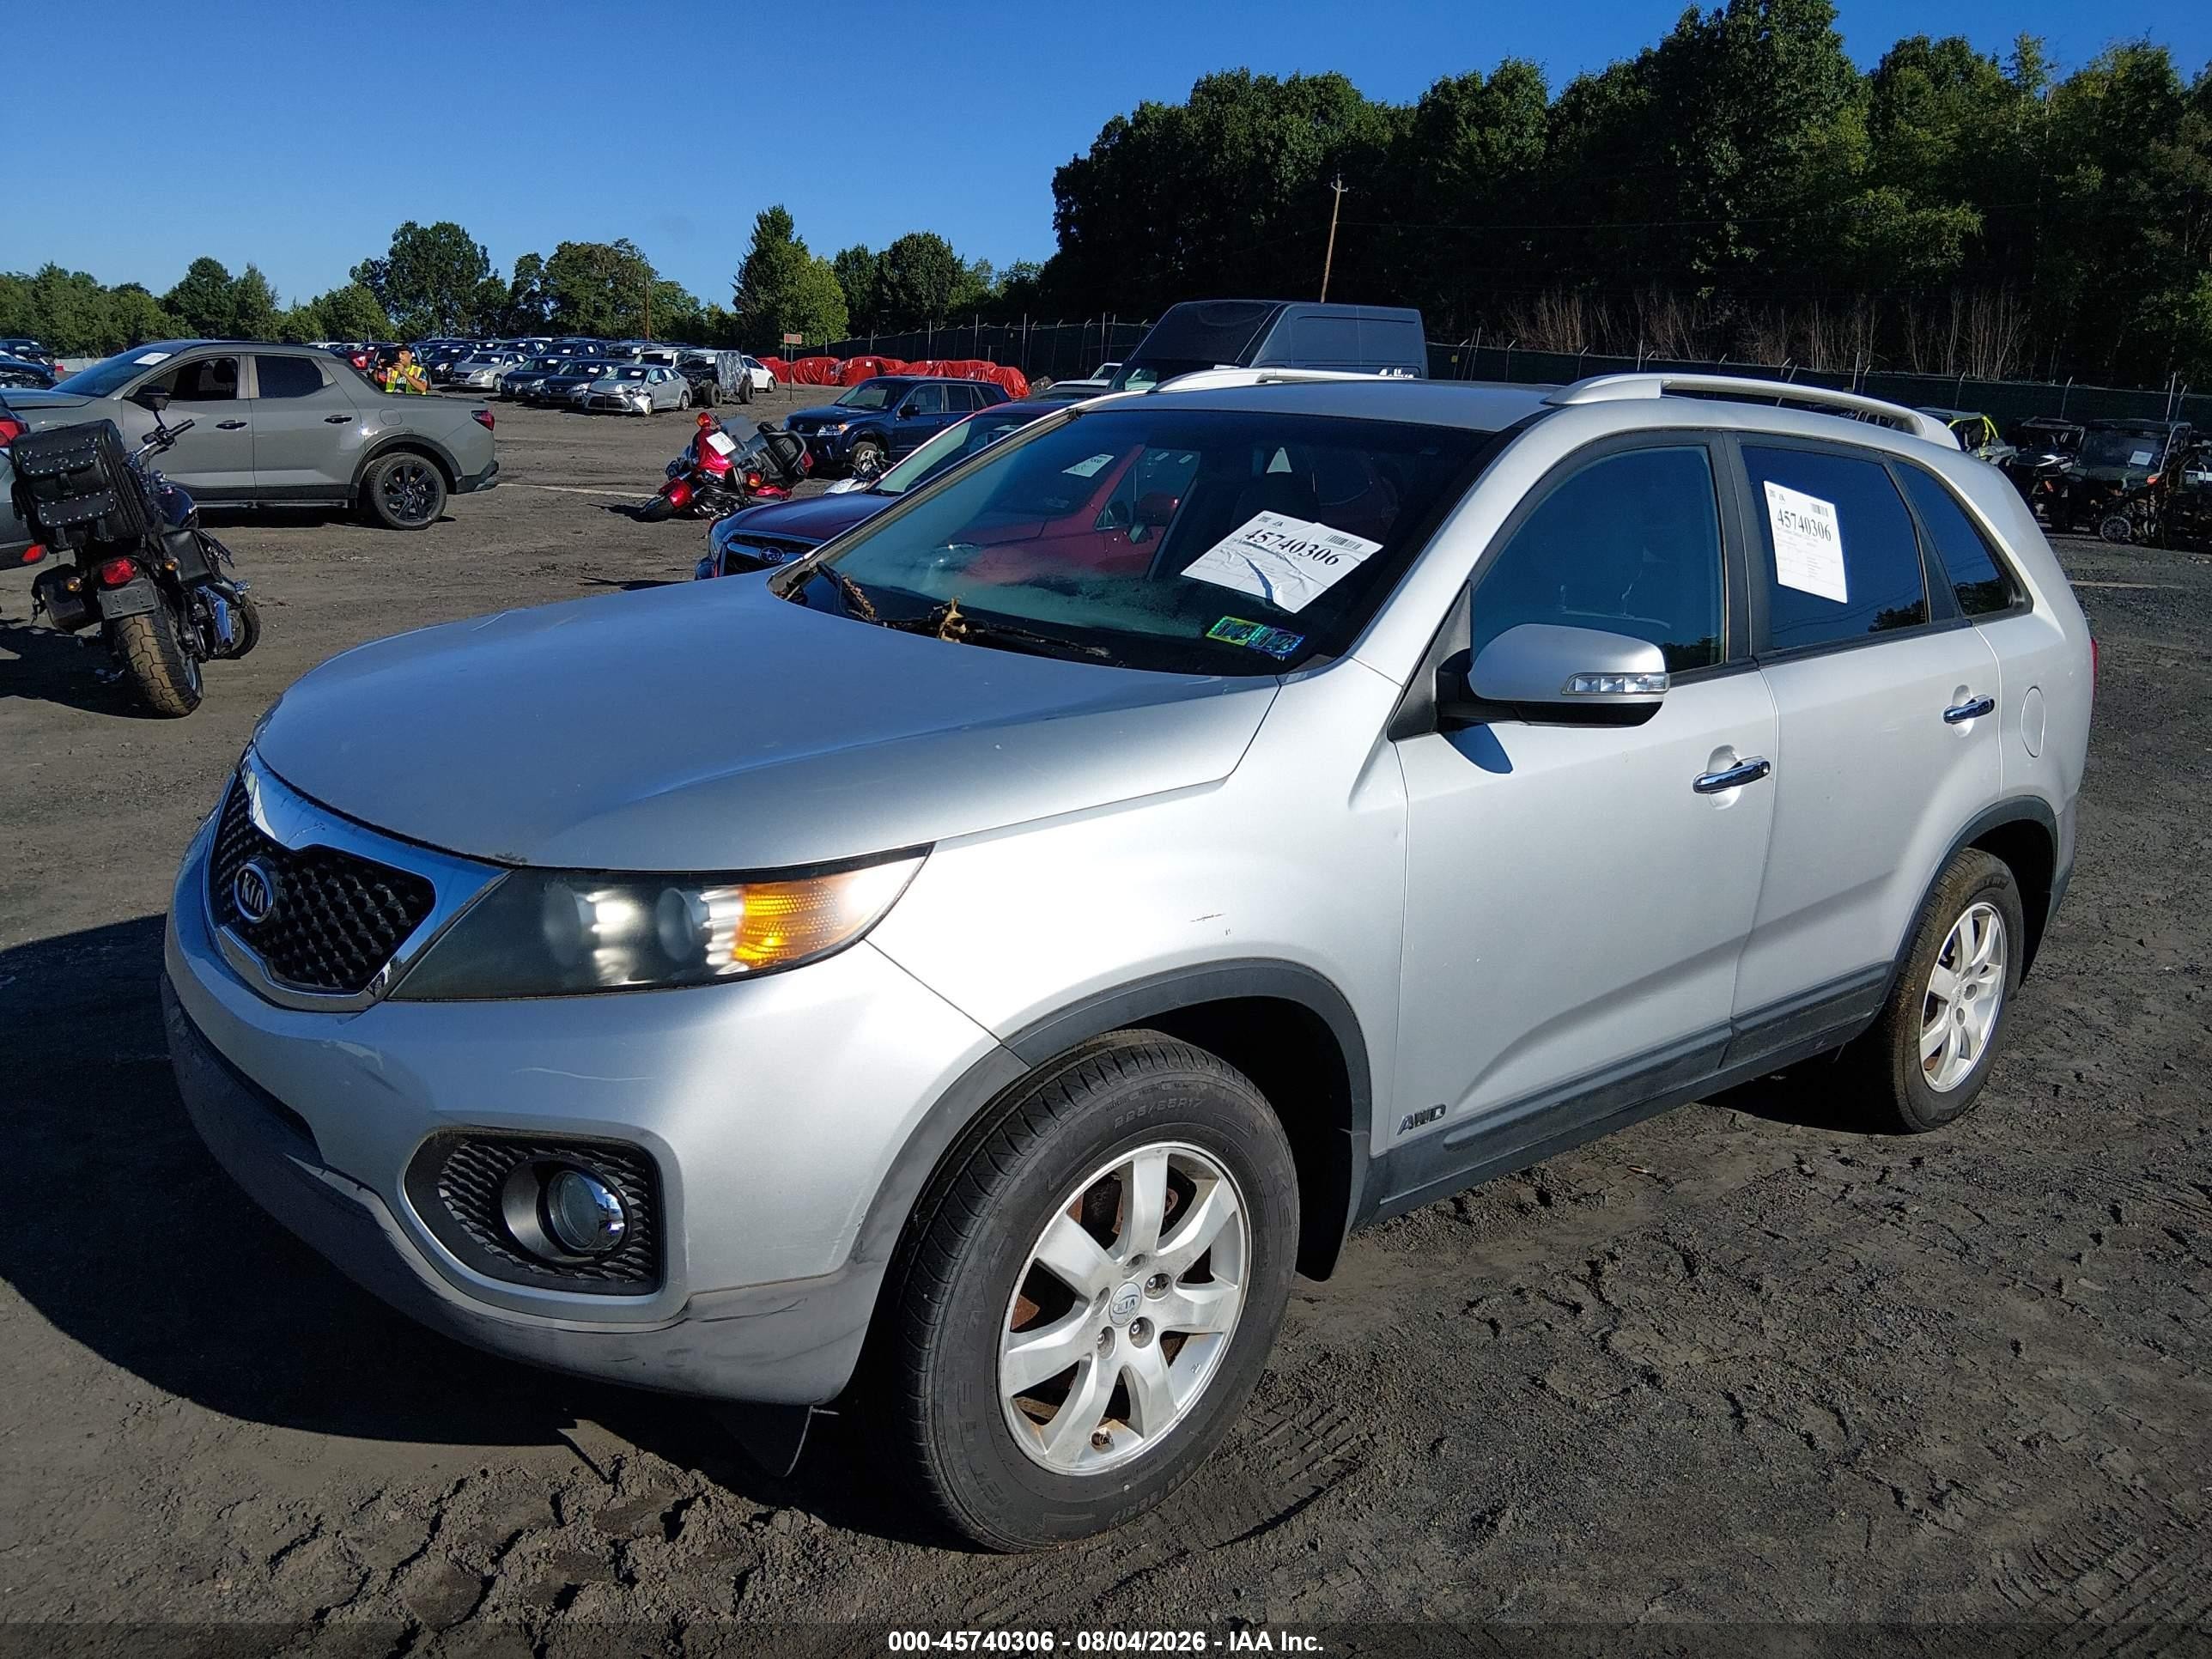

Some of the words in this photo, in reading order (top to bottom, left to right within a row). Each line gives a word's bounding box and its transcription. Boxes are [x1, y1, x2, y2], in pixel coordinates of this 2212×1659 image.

[1778, 508, 1832, 542] 45740306
[1245, 529, 1340, 567] 45740306
[1395, 1103, 1447, 1136] AWD
